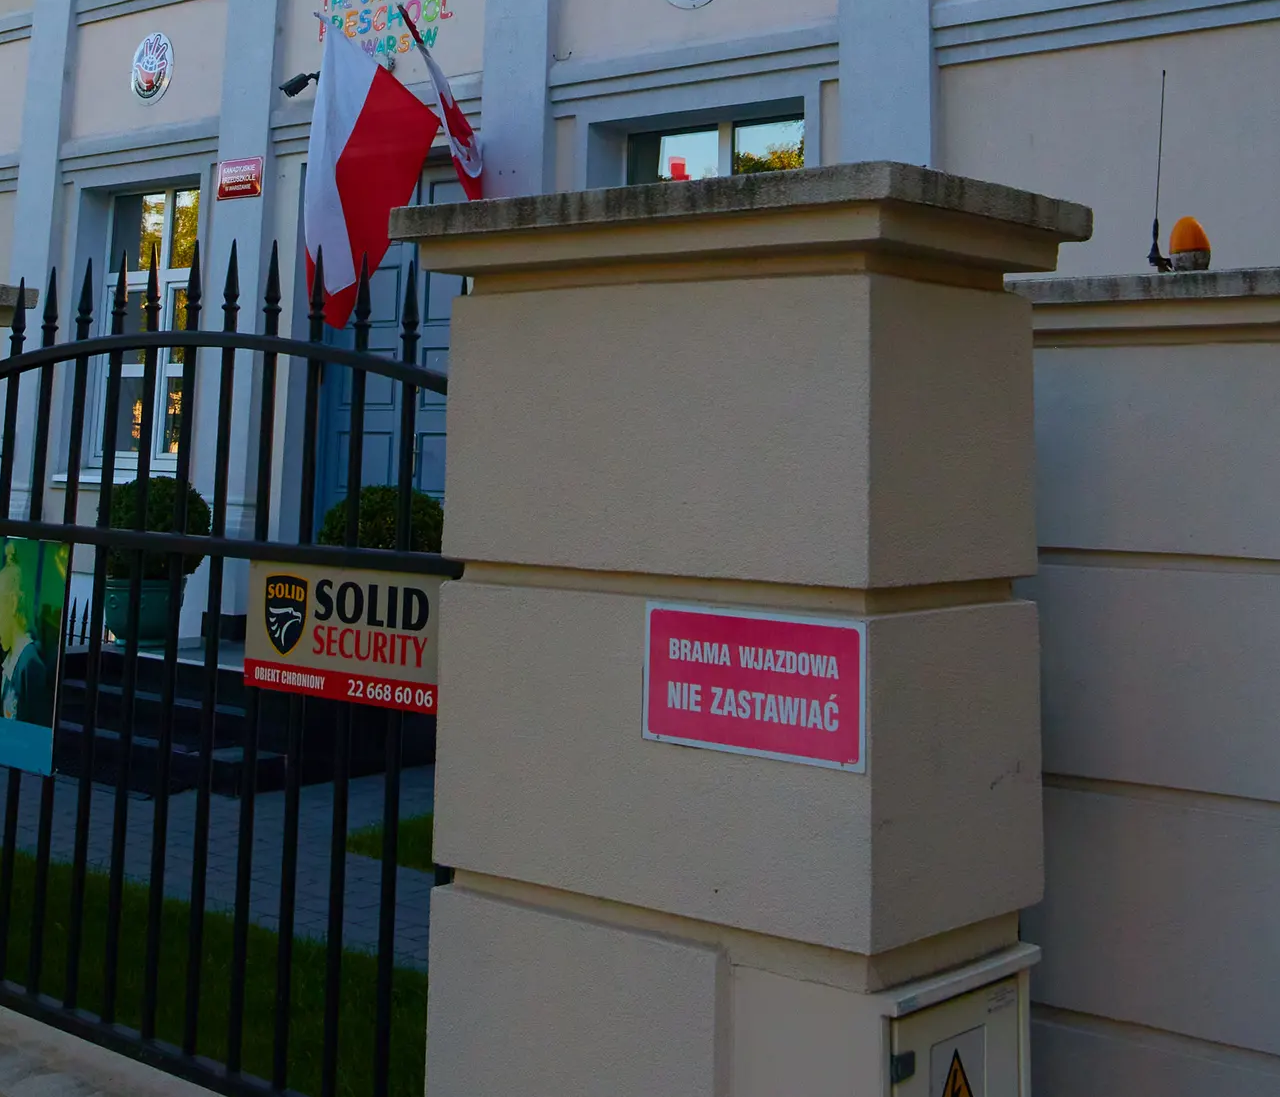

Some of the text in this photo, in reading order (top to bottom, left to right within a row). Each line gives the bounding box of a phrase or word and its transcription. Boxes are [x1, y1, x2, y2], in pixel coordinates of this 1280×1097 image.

[268, 582, 305, 602] SOLID
[314, 579, 429, 631] SOLID
[312, 625, 428, 668] SECURITY
[669, 637, 839, 680] BRAMA WJAZDOWA
[254, 665, 433, 708] OBIEKT CHRONIONY 22 668 60 06
[667, 680, 840, 732] NIE ZASTAWIAĆ
